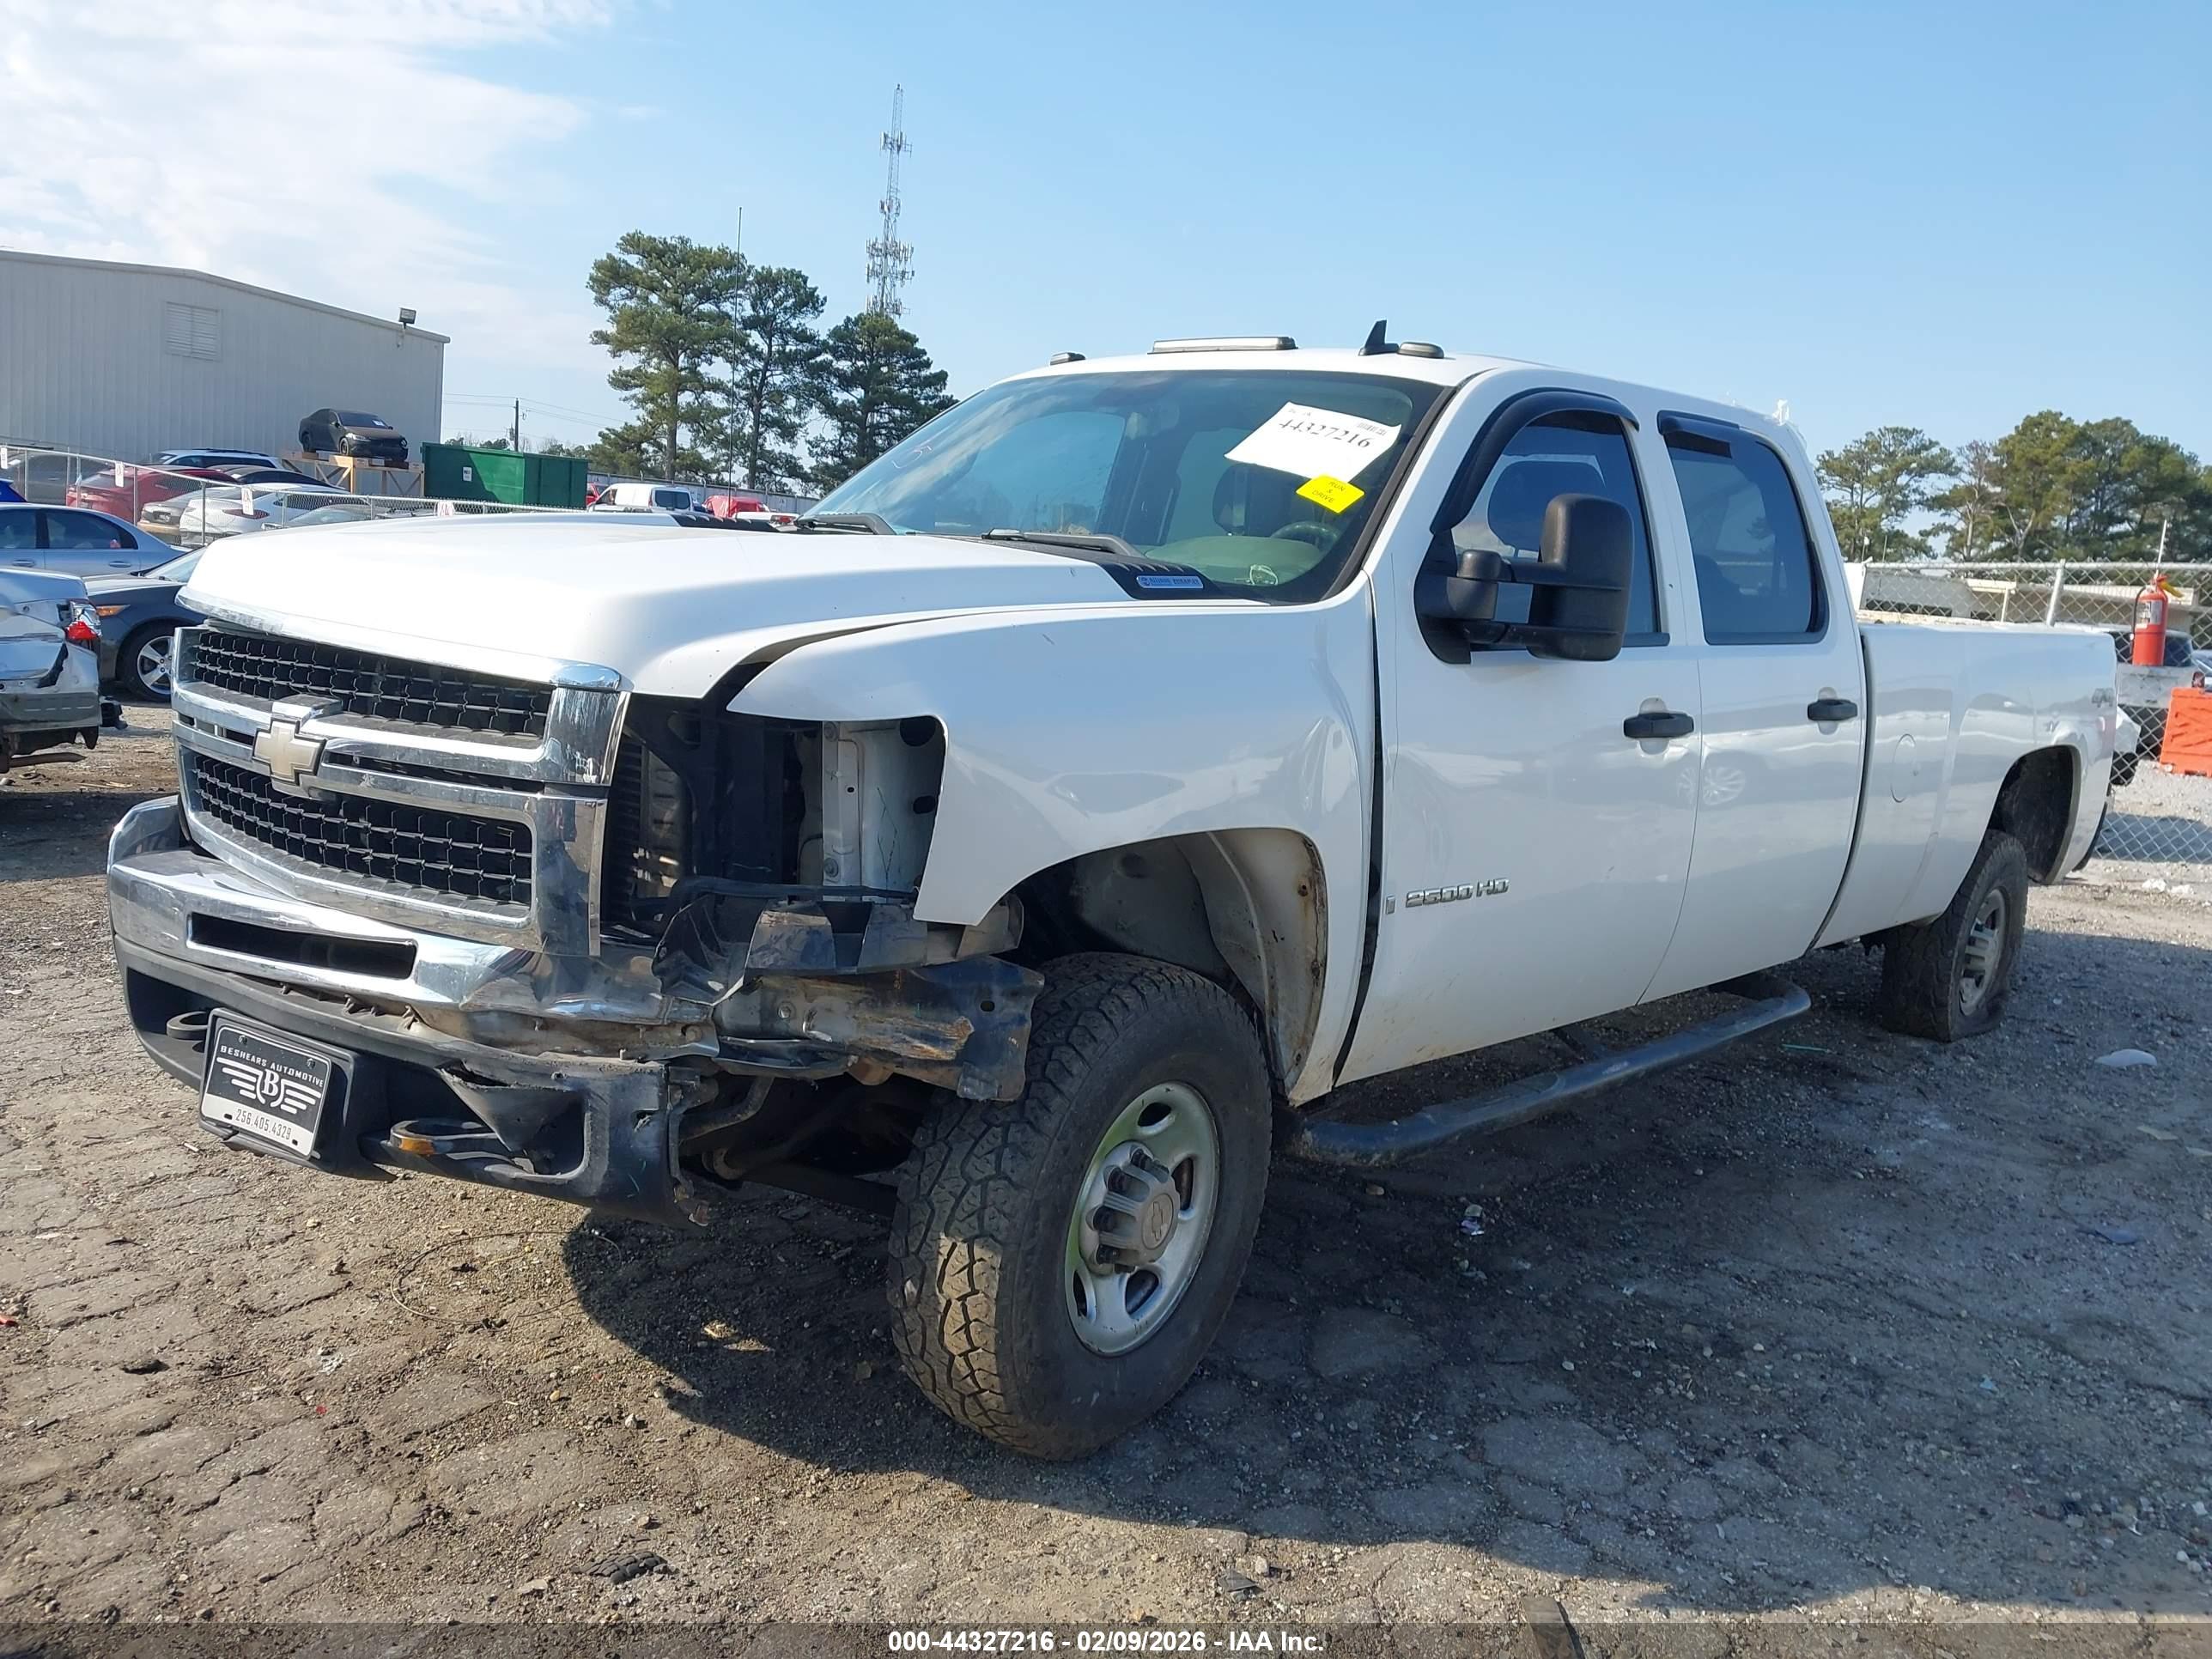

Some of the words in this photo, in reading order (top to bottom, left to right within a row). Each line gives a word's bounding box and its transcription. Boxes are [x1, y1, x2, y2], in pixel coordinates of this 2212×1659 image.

[1279, 418, 1375, 447] 44327216
[1312, 489, 1335, 504] DRIVE
[1328, 481, 1346, 492] RUN
[1405, 883, 1474, 908] 2500
[1475, 877, 1510, 897] HD
[220, 1045, 267, 1066] BESHEARS
[270, 1062, 324, 1088] AUTOMOTIVE
[261, 1069, 280, 1097] B
[234, 1109, 292, 1140] 256.405.4329
